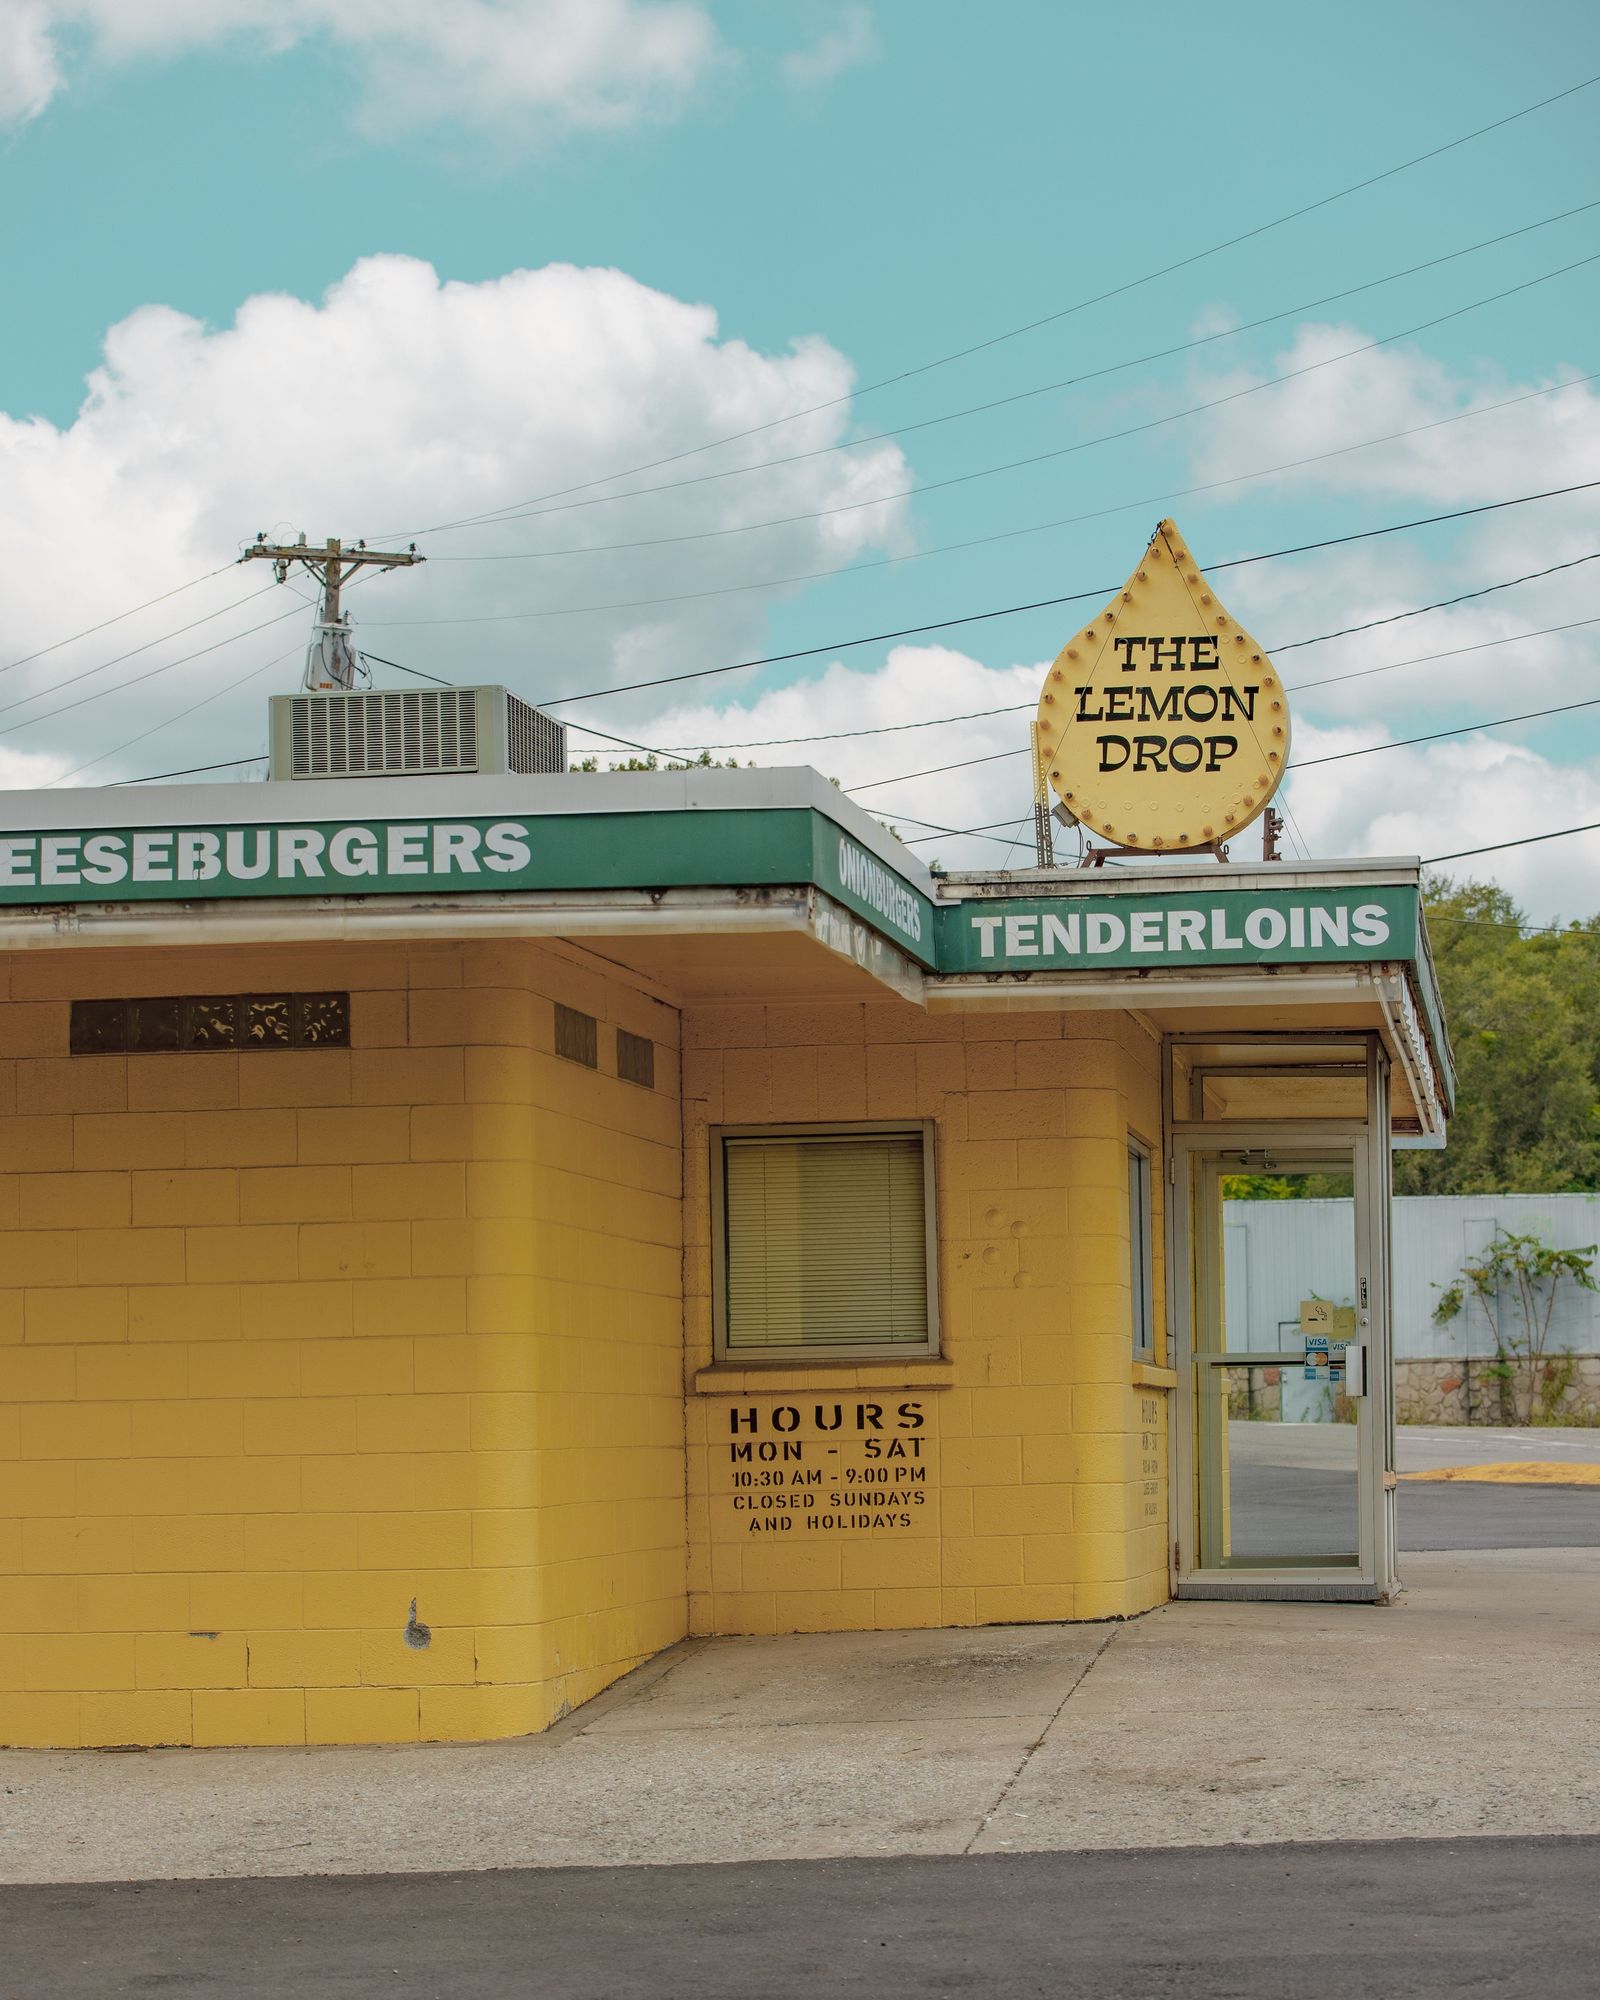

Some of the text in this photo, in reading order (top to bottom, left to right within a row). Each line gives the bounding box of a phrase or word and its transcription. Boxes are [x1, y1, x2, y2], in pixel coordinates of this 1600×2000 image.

[1114, 635, 1220, 672] THE
[1074, 684, 1260, 723] LEMON
[1095, 734, 1239, 773] DROP
[0, 822, 531, 886] EESEBURGERS
[839, 838, 921, 942] ONIONBURGERS
[971, 904, 1390, 958] TENDERLOINS
[1309, 1338, 1328, 1346] VISA
[730, 1402, 925, 1434] HOURS
[730, 1440, 802, 1463] MON
[864, 1437, 926, 1459] SAT
[731, 1470, 784, 1488] 10:30
[791, 1469, 822, 1486] AM
[845, 1467, 888, 1484] 9:00
[895, 1466, 926, 1483] PM
[733, 1490, 925, 1510] CLOSED SUNDAYS
[749, 1513, 911, 1532] AND HOLIDAYS
